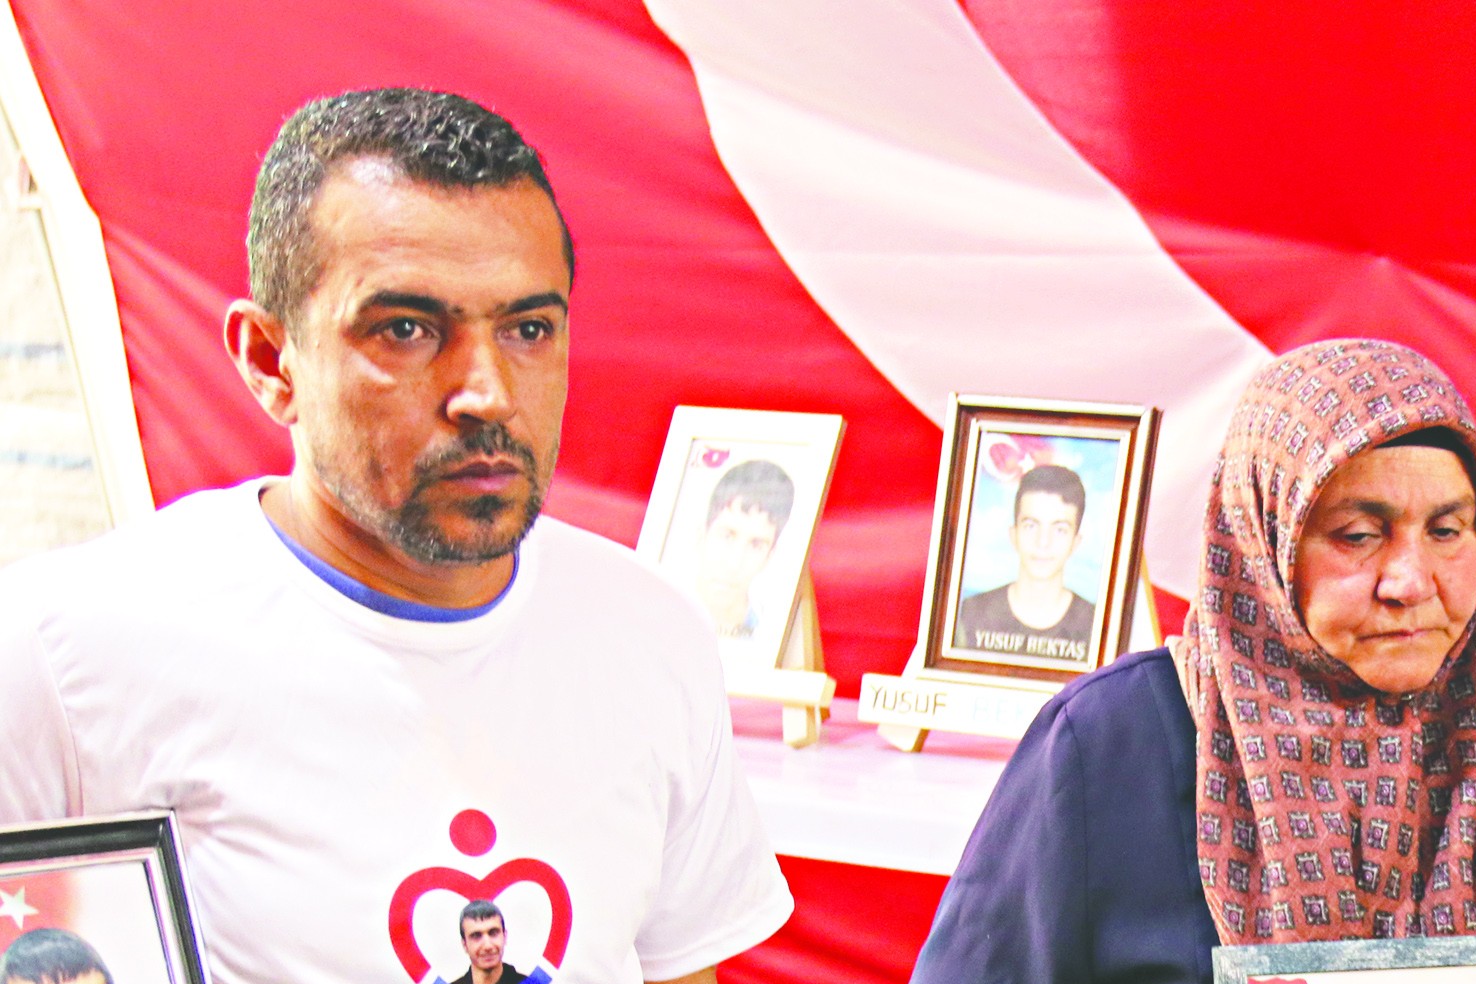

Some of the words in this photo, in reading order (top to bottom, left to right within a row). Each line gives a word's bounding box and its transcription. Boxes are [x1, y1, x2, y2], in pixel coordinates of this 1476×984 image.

[975, 629, 1026, 652] YUSUF
[1026, 634, 1087, 661] BEKTAŞ
[869, 684, 948, 716] YUSUF
